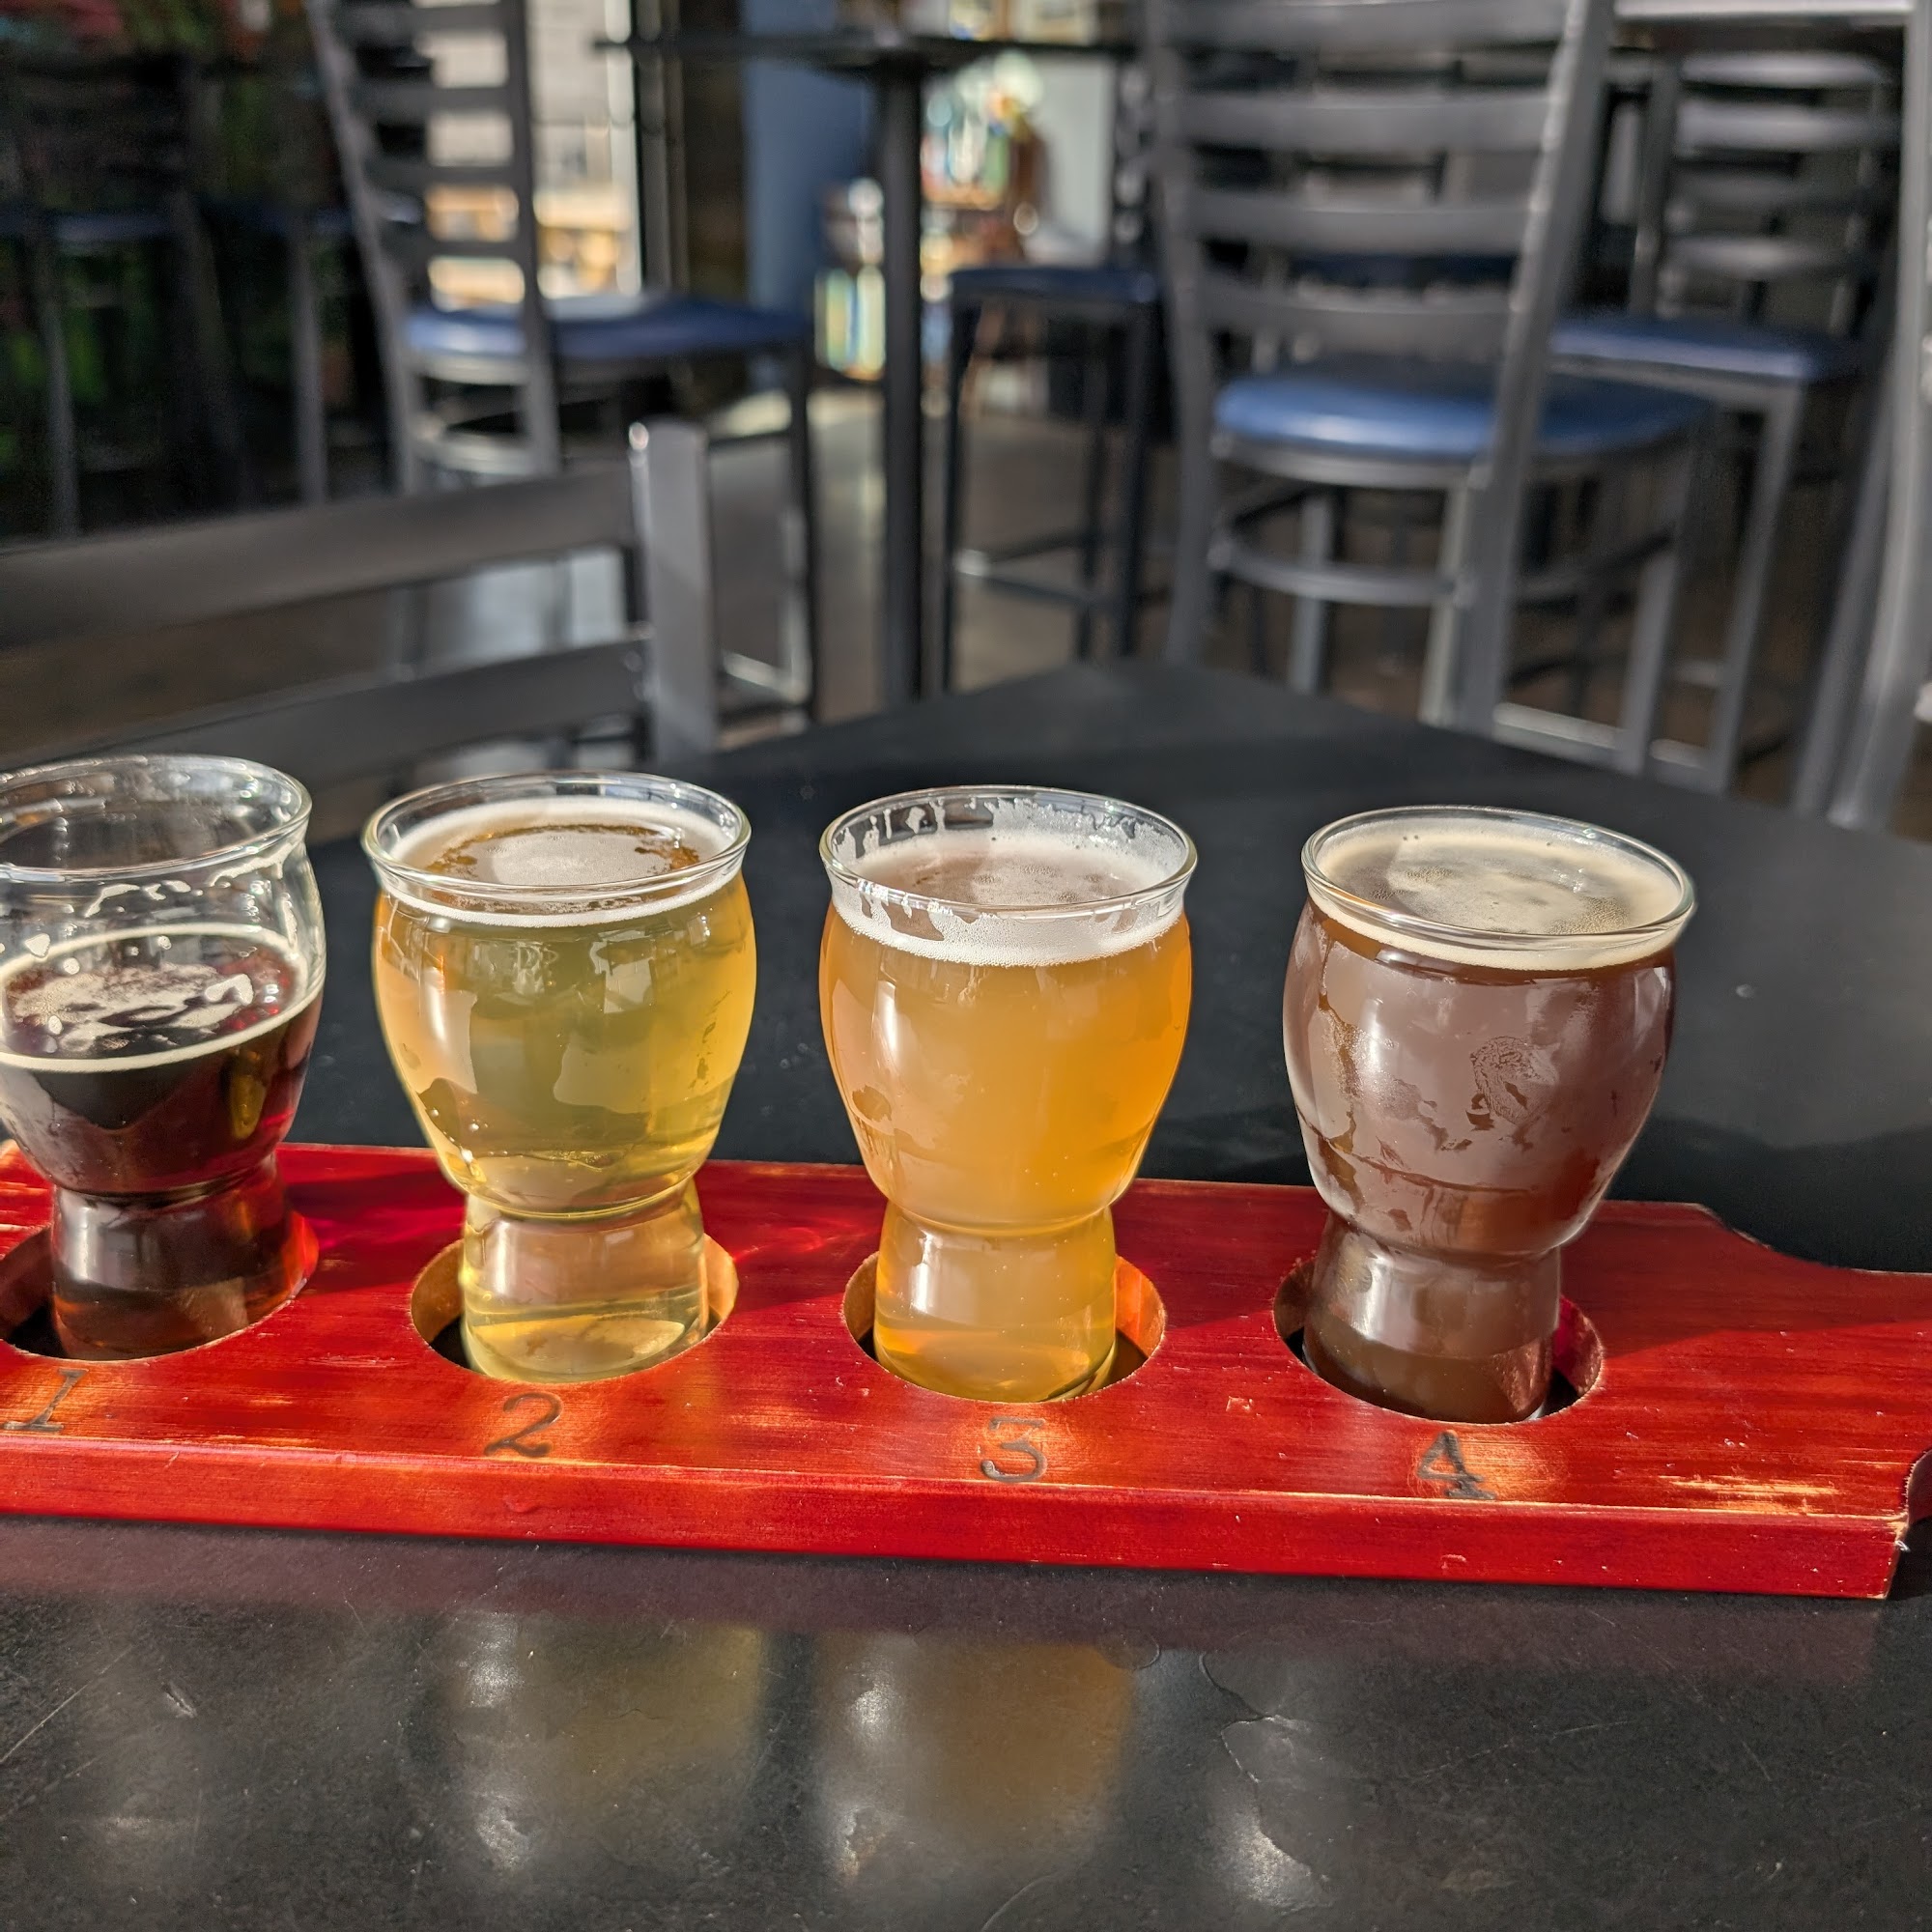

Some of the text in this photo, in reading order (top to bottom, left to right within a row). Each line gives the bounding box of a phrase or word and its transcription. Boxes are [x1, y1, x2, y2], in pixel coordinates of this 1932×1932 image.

[3, 1367, 90, 1433] 1
[484, 1391, 563, 1458] 2
[980, 1415, 1048, 1483] 3
[1416, 1430, 1497, 1500] 4
